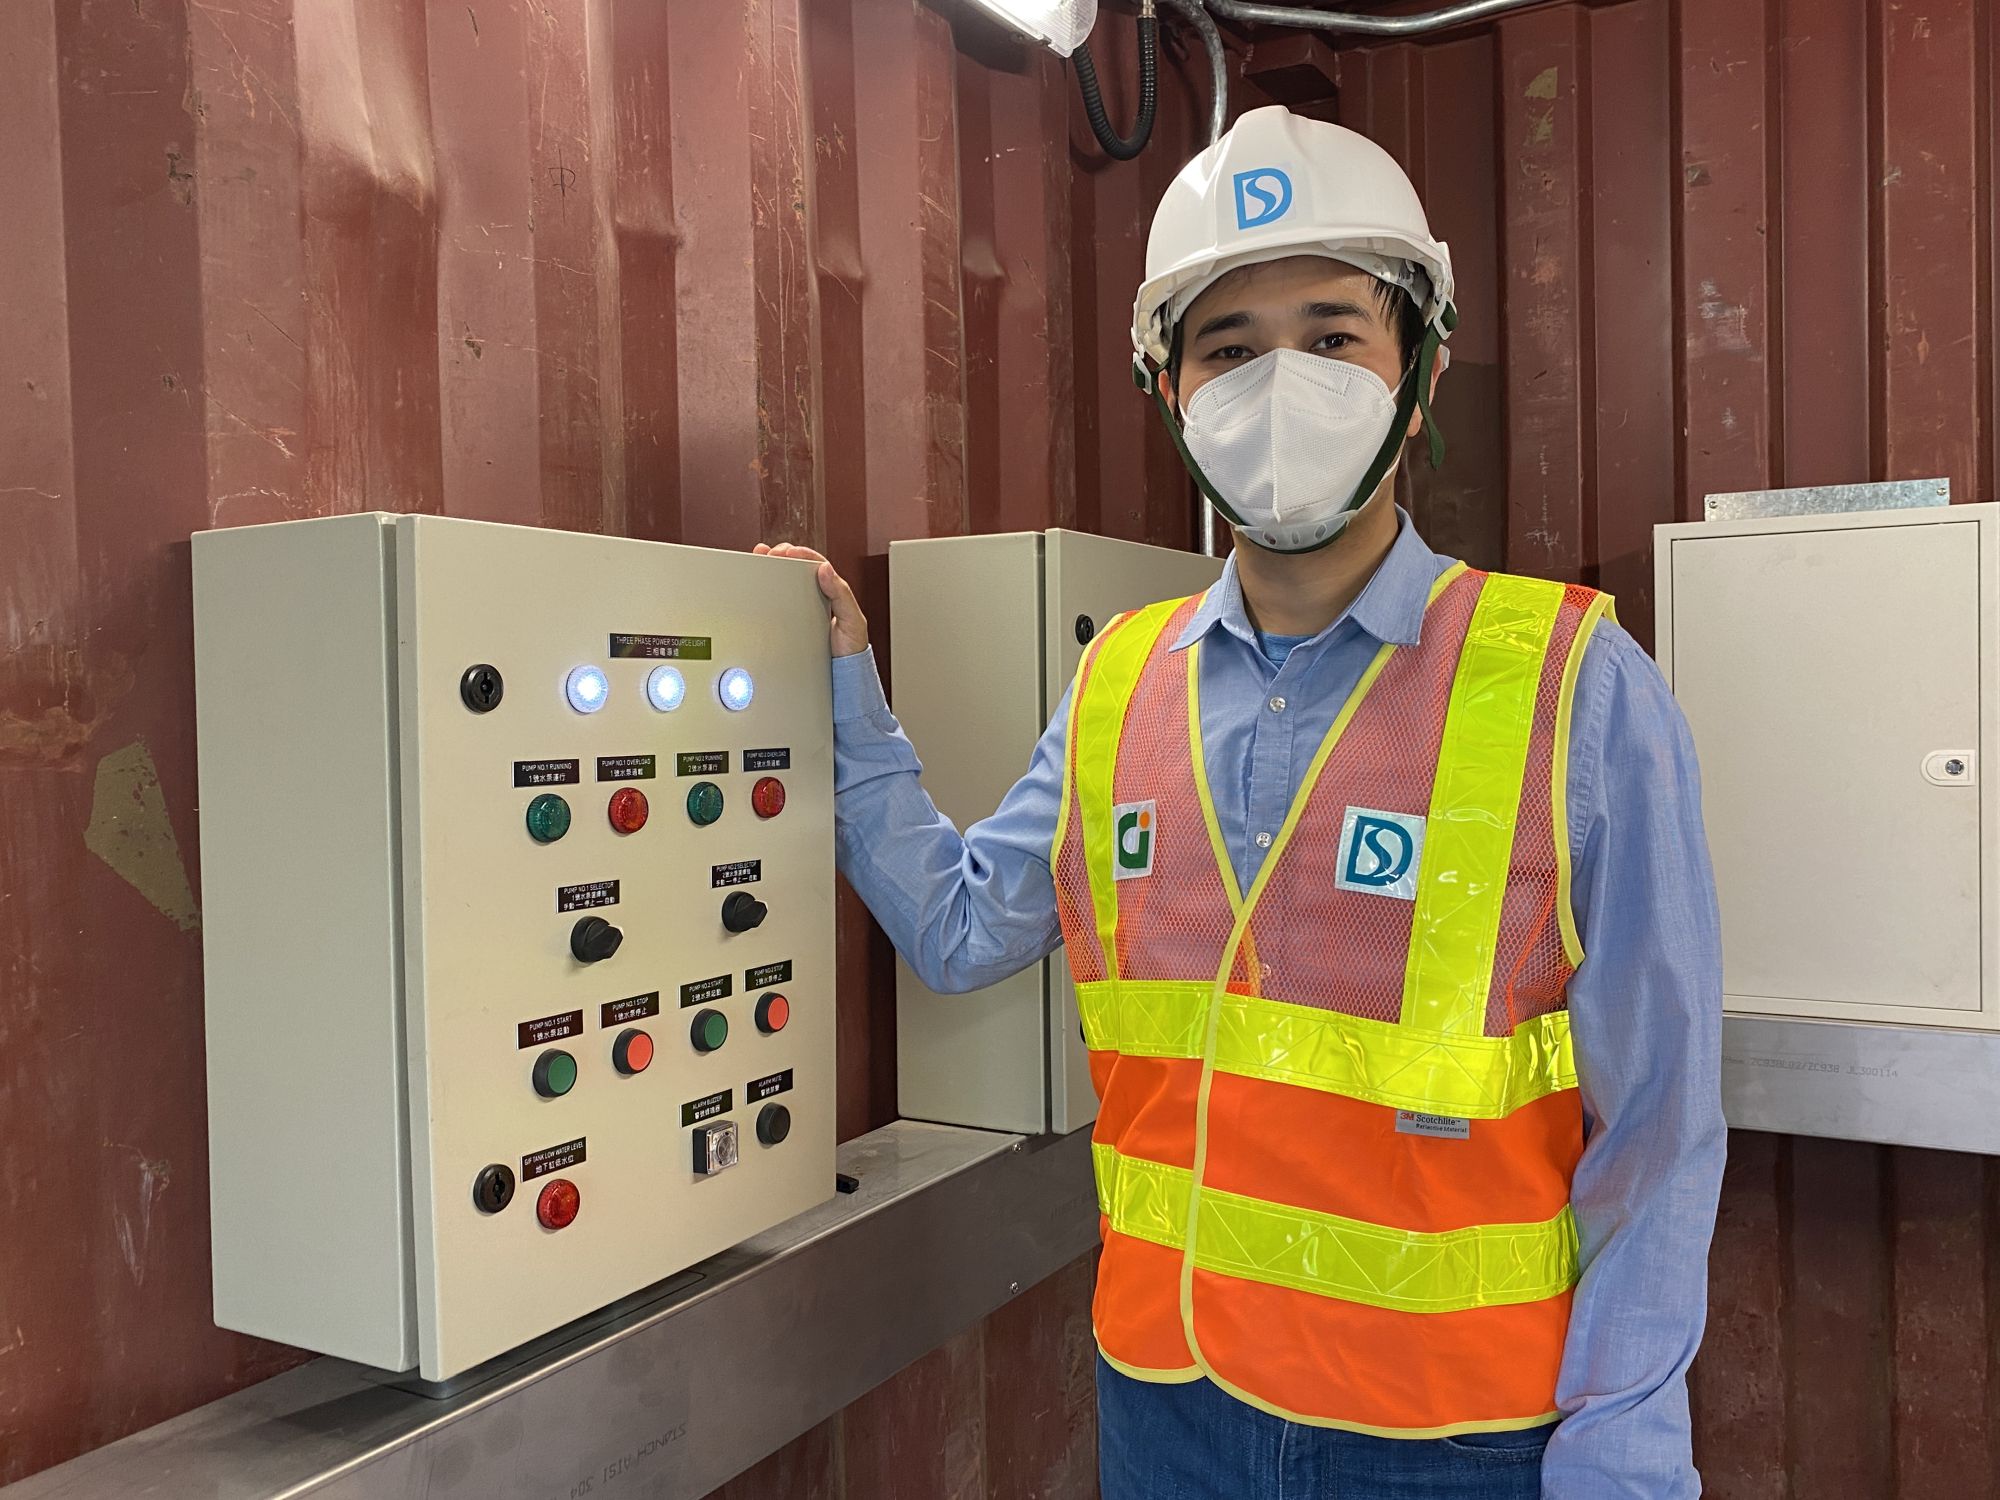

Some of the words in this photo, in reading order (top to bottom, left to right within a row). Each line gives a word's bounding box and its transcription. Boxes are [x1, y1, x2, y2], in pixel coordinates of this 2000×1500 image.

[616, 636, 634, 645] THREE
[634, 637, 652, 646] PHASE
[652, 638, 670, 646] POWER
[672, 638, 691, 646] SOURCE
[692, 639, 706, 647] LIGHT
[590, 882, 614, 890] SELECTOR
[711, 979, 724, 987] START
[612, 1002, 625, 1011] PUMP
[637, 997, 648, 1005] STOP
[530, 1021, 544, 1031] PUMP
[557, 1015, 572, 1024] START
[693, 1100, 707, 1110] ALARM
[1400, 1112, 1414, 1120] 3M
[533, 1154, 545, 1162] TANK
[545, 1151, 554, 1159] LOW
[556, 1145, 570, 1155] WATER
[571, 1142, 584, 1151] LEVEL
